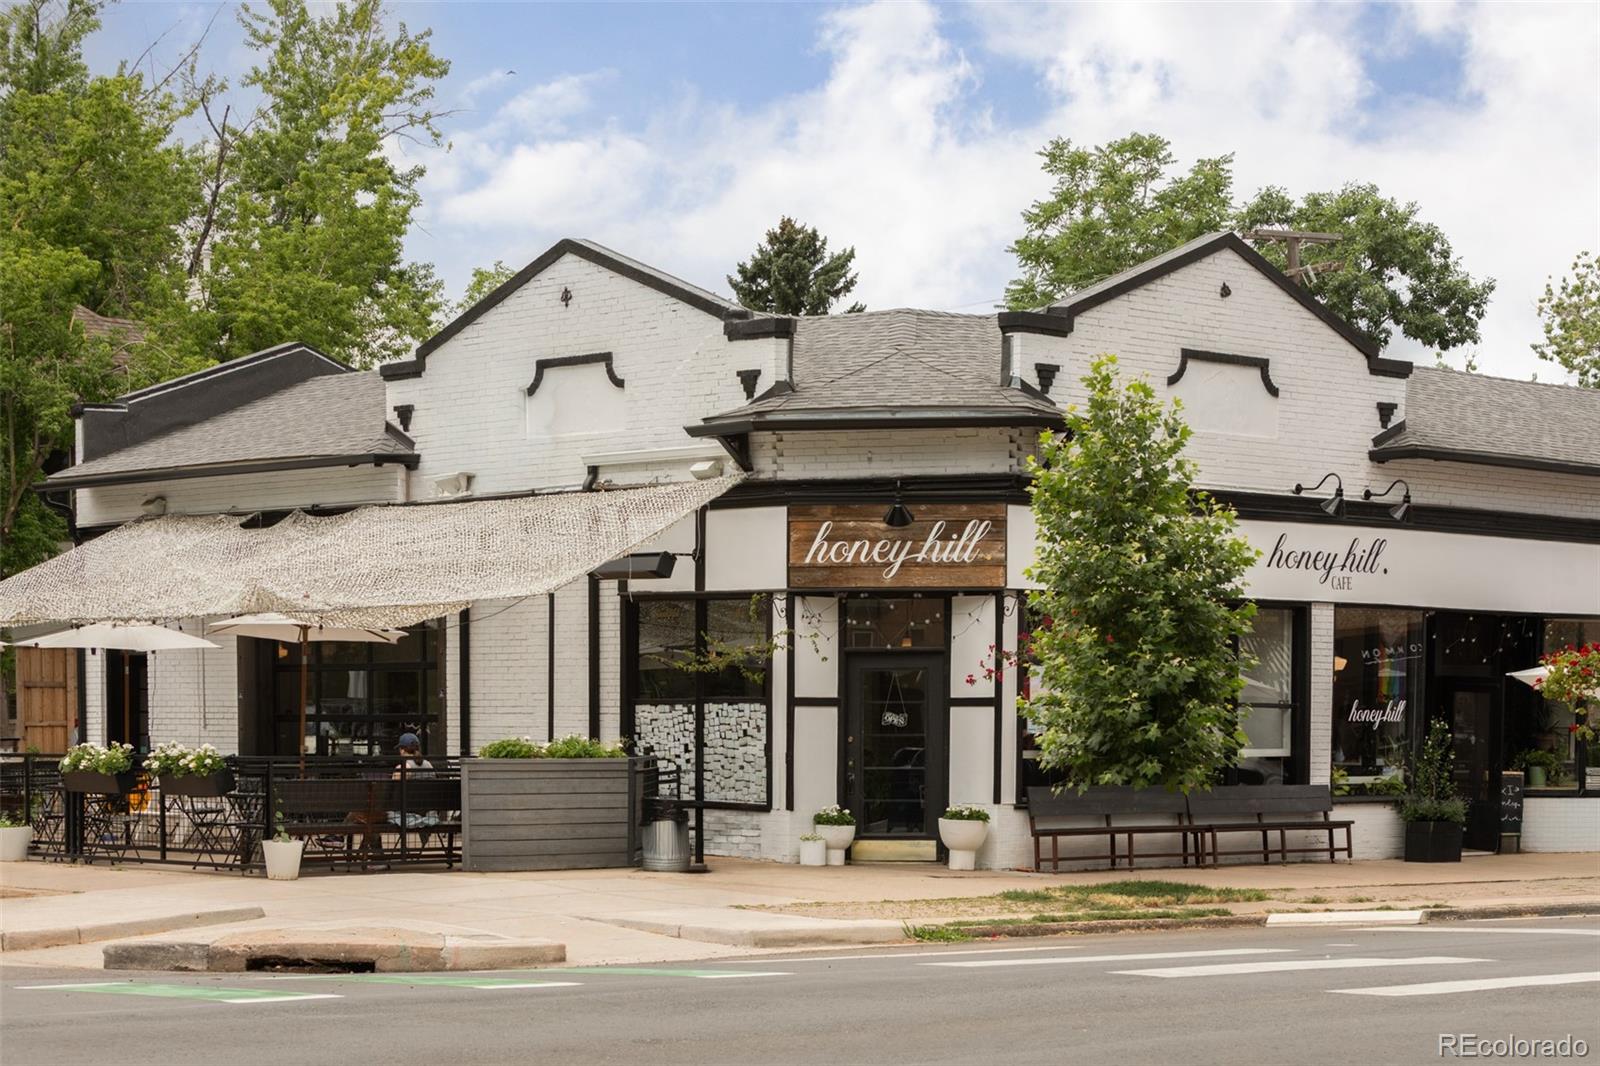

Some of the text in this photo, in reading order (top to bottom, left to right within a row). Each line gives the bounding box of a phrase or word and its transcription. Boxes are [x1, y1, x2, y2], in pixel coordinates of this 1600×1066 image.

[804, 520, 913, 579] honey
[1266, 532, 1340, 584] honey
[1331, 576, 1353, 590] CAFE
[1347, 699, 1384, 731] honey
